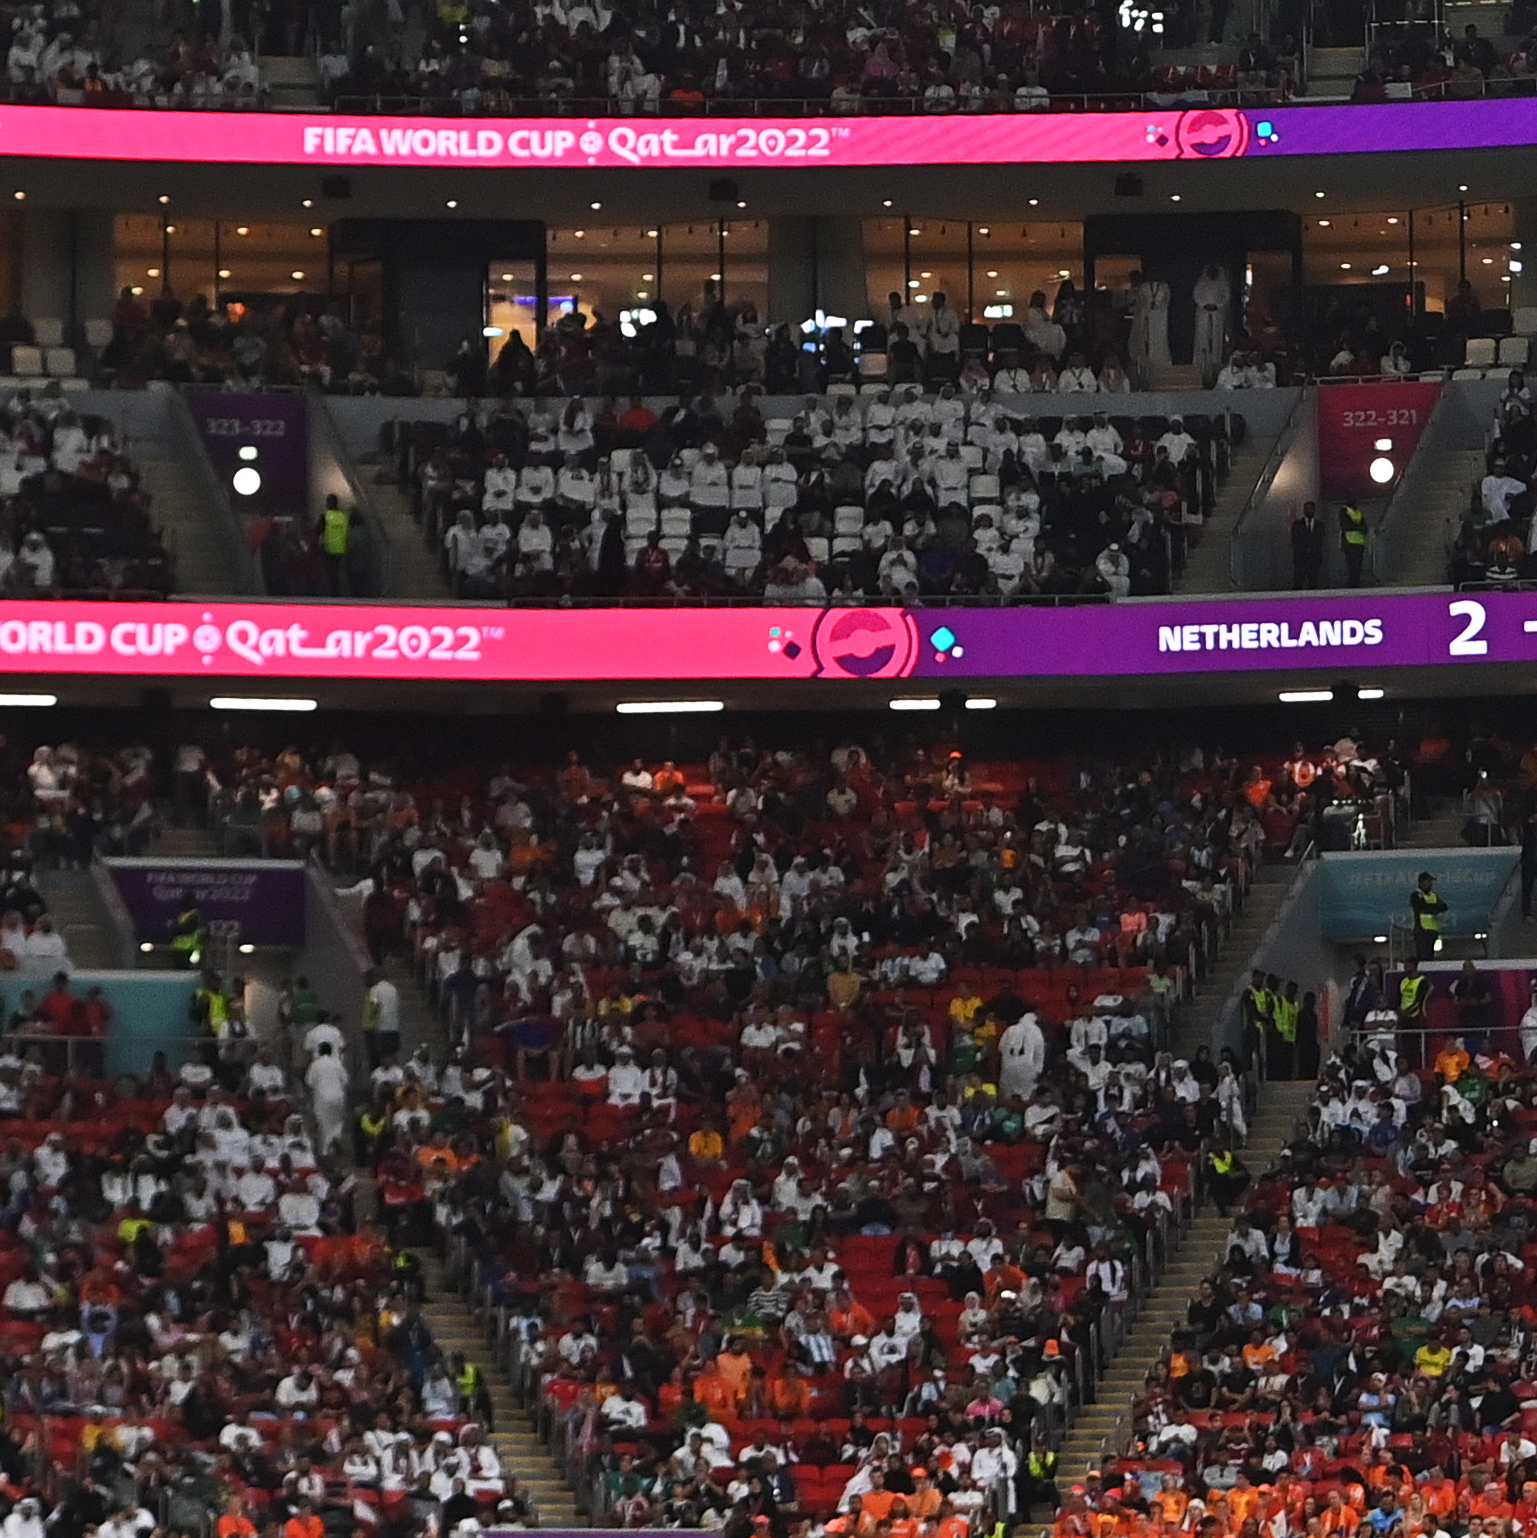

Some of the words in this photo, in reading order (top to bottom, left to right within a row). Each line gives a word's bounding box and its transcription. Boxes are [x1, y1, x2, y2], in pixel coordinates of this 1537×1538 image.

[305, 126, 383, 154] FIFA
[386, 128, 503, 156] WORLD
[512, 130, 574, 156] CUP
[1342, 408, 1417, 428] 322-321
[111, 622, 188, 655] CUP
[1159, 619, 1382, 651] NETHERLANDS
[1450, 601, 1487, 655] 2
